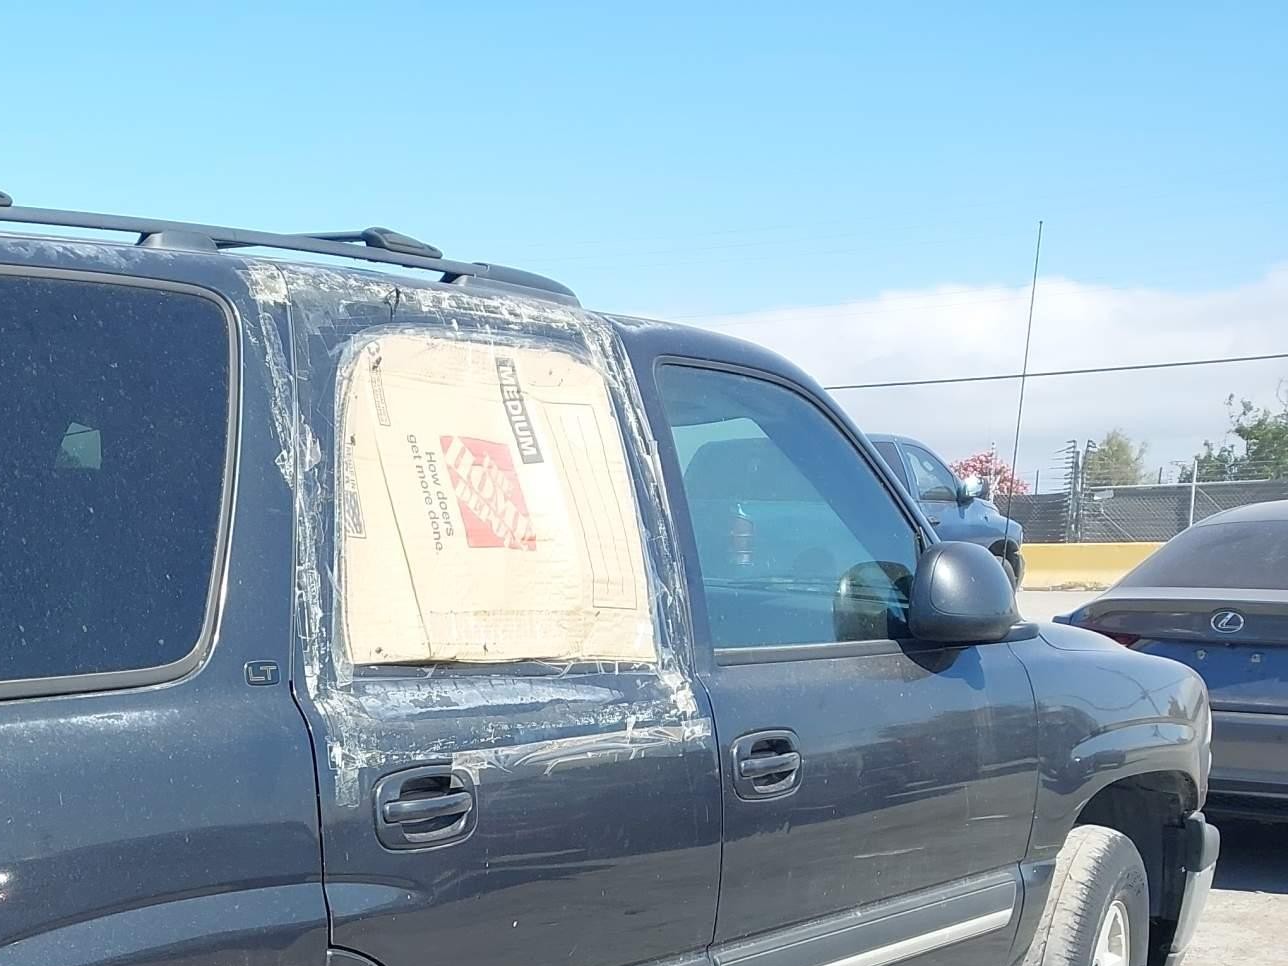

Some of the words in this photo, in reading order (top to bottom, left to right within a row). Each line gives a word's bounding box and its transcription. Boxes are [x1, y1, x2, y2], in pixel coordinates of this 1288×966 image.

[498, 366, 539, 456] MEDIUM
[407, 434, 422, 460] get
[416, 464, 433, 506] more
[425, 451, 441, 487] How
[436, 490, 454, 537] doers
[443, 435, 532, 544] HOME
[248, 665, 278, 681] LT
